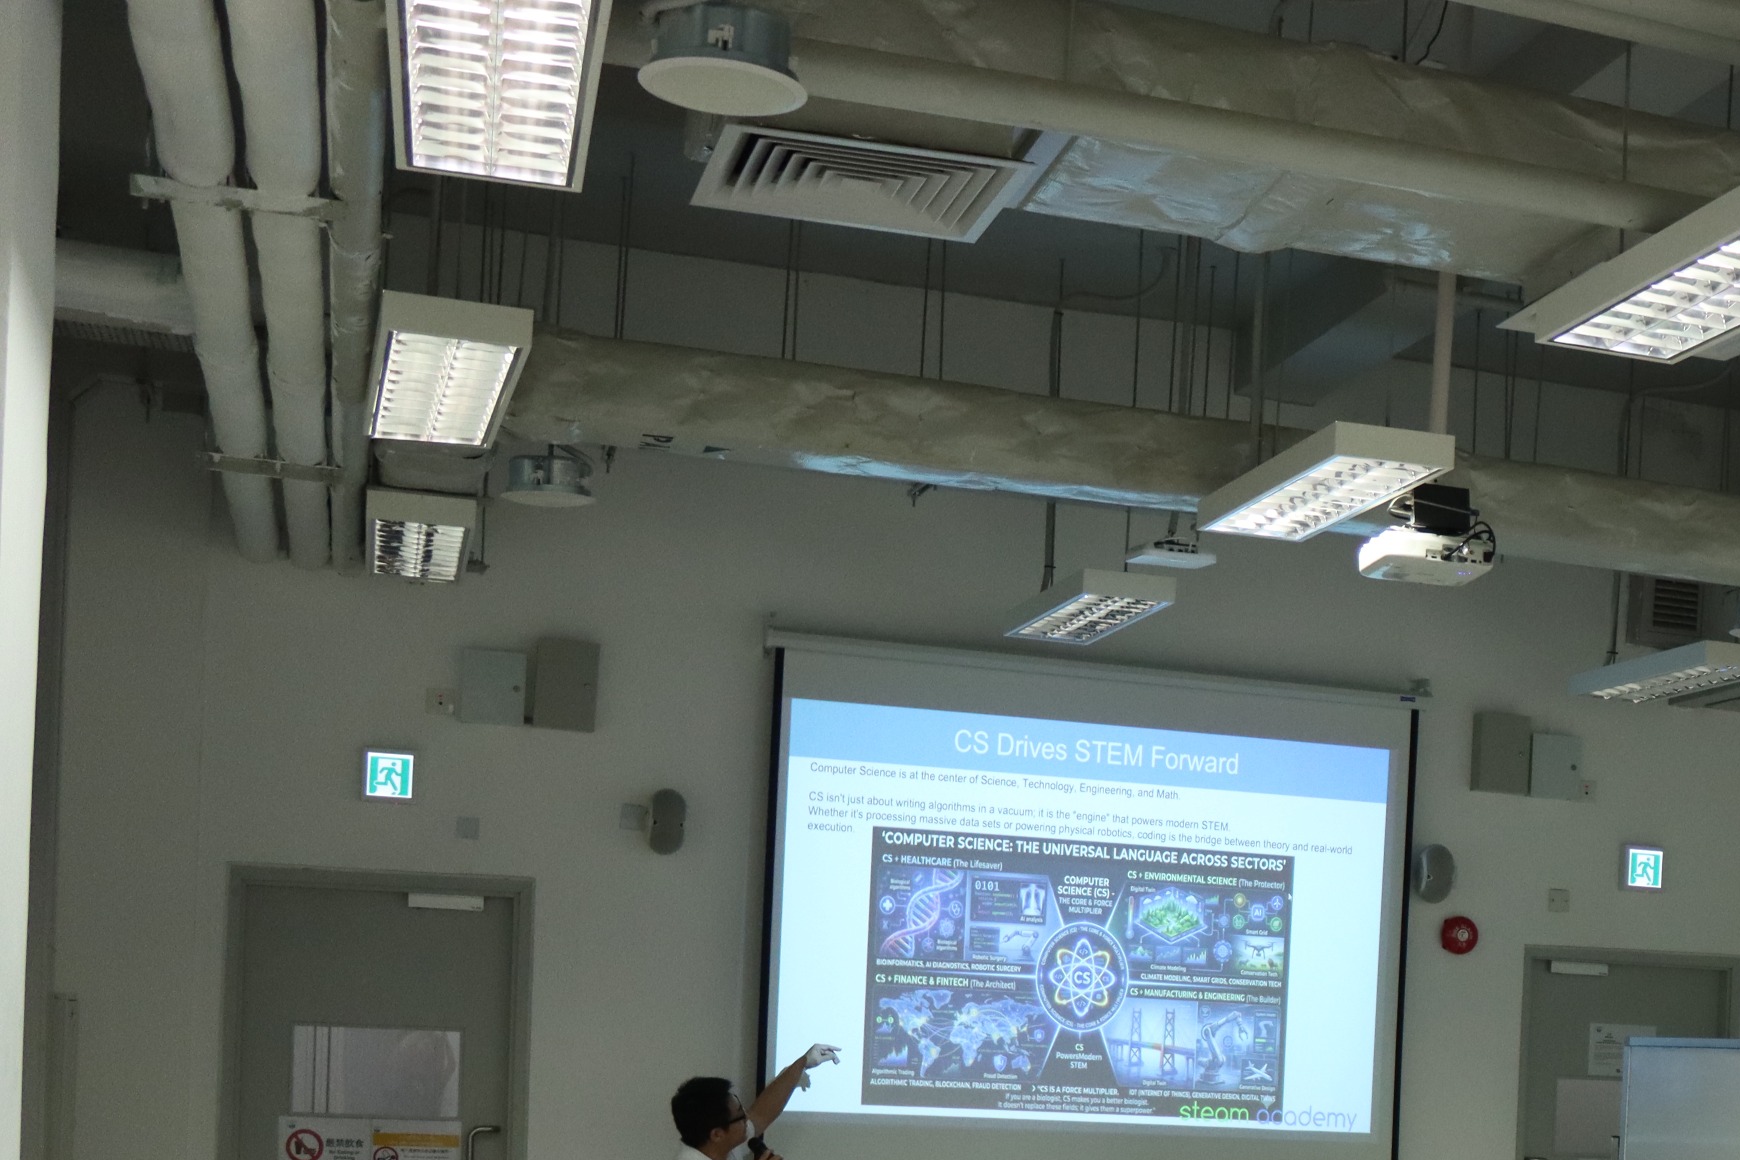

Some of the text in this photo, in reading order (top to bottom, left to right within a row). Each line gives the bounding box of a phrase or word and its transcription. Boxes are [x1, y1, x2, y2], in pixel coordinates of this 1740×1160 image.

[953, 728, 1239, 775] CS Drives STEM Forward
[810, 761, 1180, 800] Computer Science is at the center of Science, Technology, Engineering, and Math.
[809, 791, 823, 801] CS
[826, 792, 844, 803] isn't
[847, 794, 864, 806] just
[866, 795, 892, 806] about
[895, 797, 925, 811] writing
[928, 800, 975, 815] algorithms
[978, 803, 986, 813] in
[997, 807, 1034, 818] vacuum;
[1038, 808, 1043, 817] it
[1046, 809, 1053, 818] is
[1056, 809, 1070, 819] the
[1112, 814, 1128, 824] that
[1131, 817, 1162, 829] powers
[1165, 818, 1198, 829] modern
[1201, 820, 1230, 831] STEM.
[807, 820, 854, 832] execution.
[808, 805, 847, 817] Whether
[850, 808, 863, 819] it's
[865, 810, 916, 825] processing
[919, 814, 956, 825] massive
[959, 817, 979, 827] data
[982, 818, 1000, 829] sets
[1015, 821, 1056, 835] powering
[1058, 824, 1094, 838] physical
[1097, 827, 1134, 840] robotics,
[1137, 830, 1166, 843] coding
[1168, 832, 1175, 841] is
[1178, 833, 1192, 843] the
[1194, 834, 1221, 847] bridge
[1224, 836, 1260, 848] between
[1263, 839, 1289, 852] theory
[1292, 841, 1308, 851] and
[1310, 843, 1352, 854] real-world
[957, 836, 1012, 851] SCIENCE:
[1015, 841, 1039, 853] THE
[1042, 843, 1110, 858] UNIVERSAL
[1113, 848, 1177, 863] LANGUAGE
[1180, 852, 1227, 867] ACROSS
[882, 853, 1002, 871] CS HEALTHCARE (The Lifesaver)
[974, 880, 999, 891] 0101
[1064, 875, 1109, 886] COMPUTER
[1127, 870, 1285, 890] CS ENVIRONMENTAL SCIENCE (The Protector)
[1057, 885, 1109, 898] SCIENCE (CS)
[1068, 905, 1102, 914] MULTIPLIER
[1070, 897, 1086, 905] CORE
[1088, 898, 1092, 906] &
[1093, 899, 1112, 907] FORCE
[875, 974, 1015, 990] CS FINANCE & FINTECH (The Architect)
[1073, 970, 1091, 984] CS
[1140, 973, 1162, 981] CLIMATE
[1228, 978, 1267, 986] CONSERVATION
[1144, 988, 1197, 998] MANUFACTURING
[1198, 991, 1202, 999] &
[1204, 992, 1244, 1001] ENGINEERING
[1246, 994, 1258, 1003] (The
[1259, 995, 1280, 1005] Builder)
[1075, 1043, 1084, 1051] CS
[1070, 1061, 1087, 1069] STEM
[1179, 1100, 1357, 1133] steam academy
